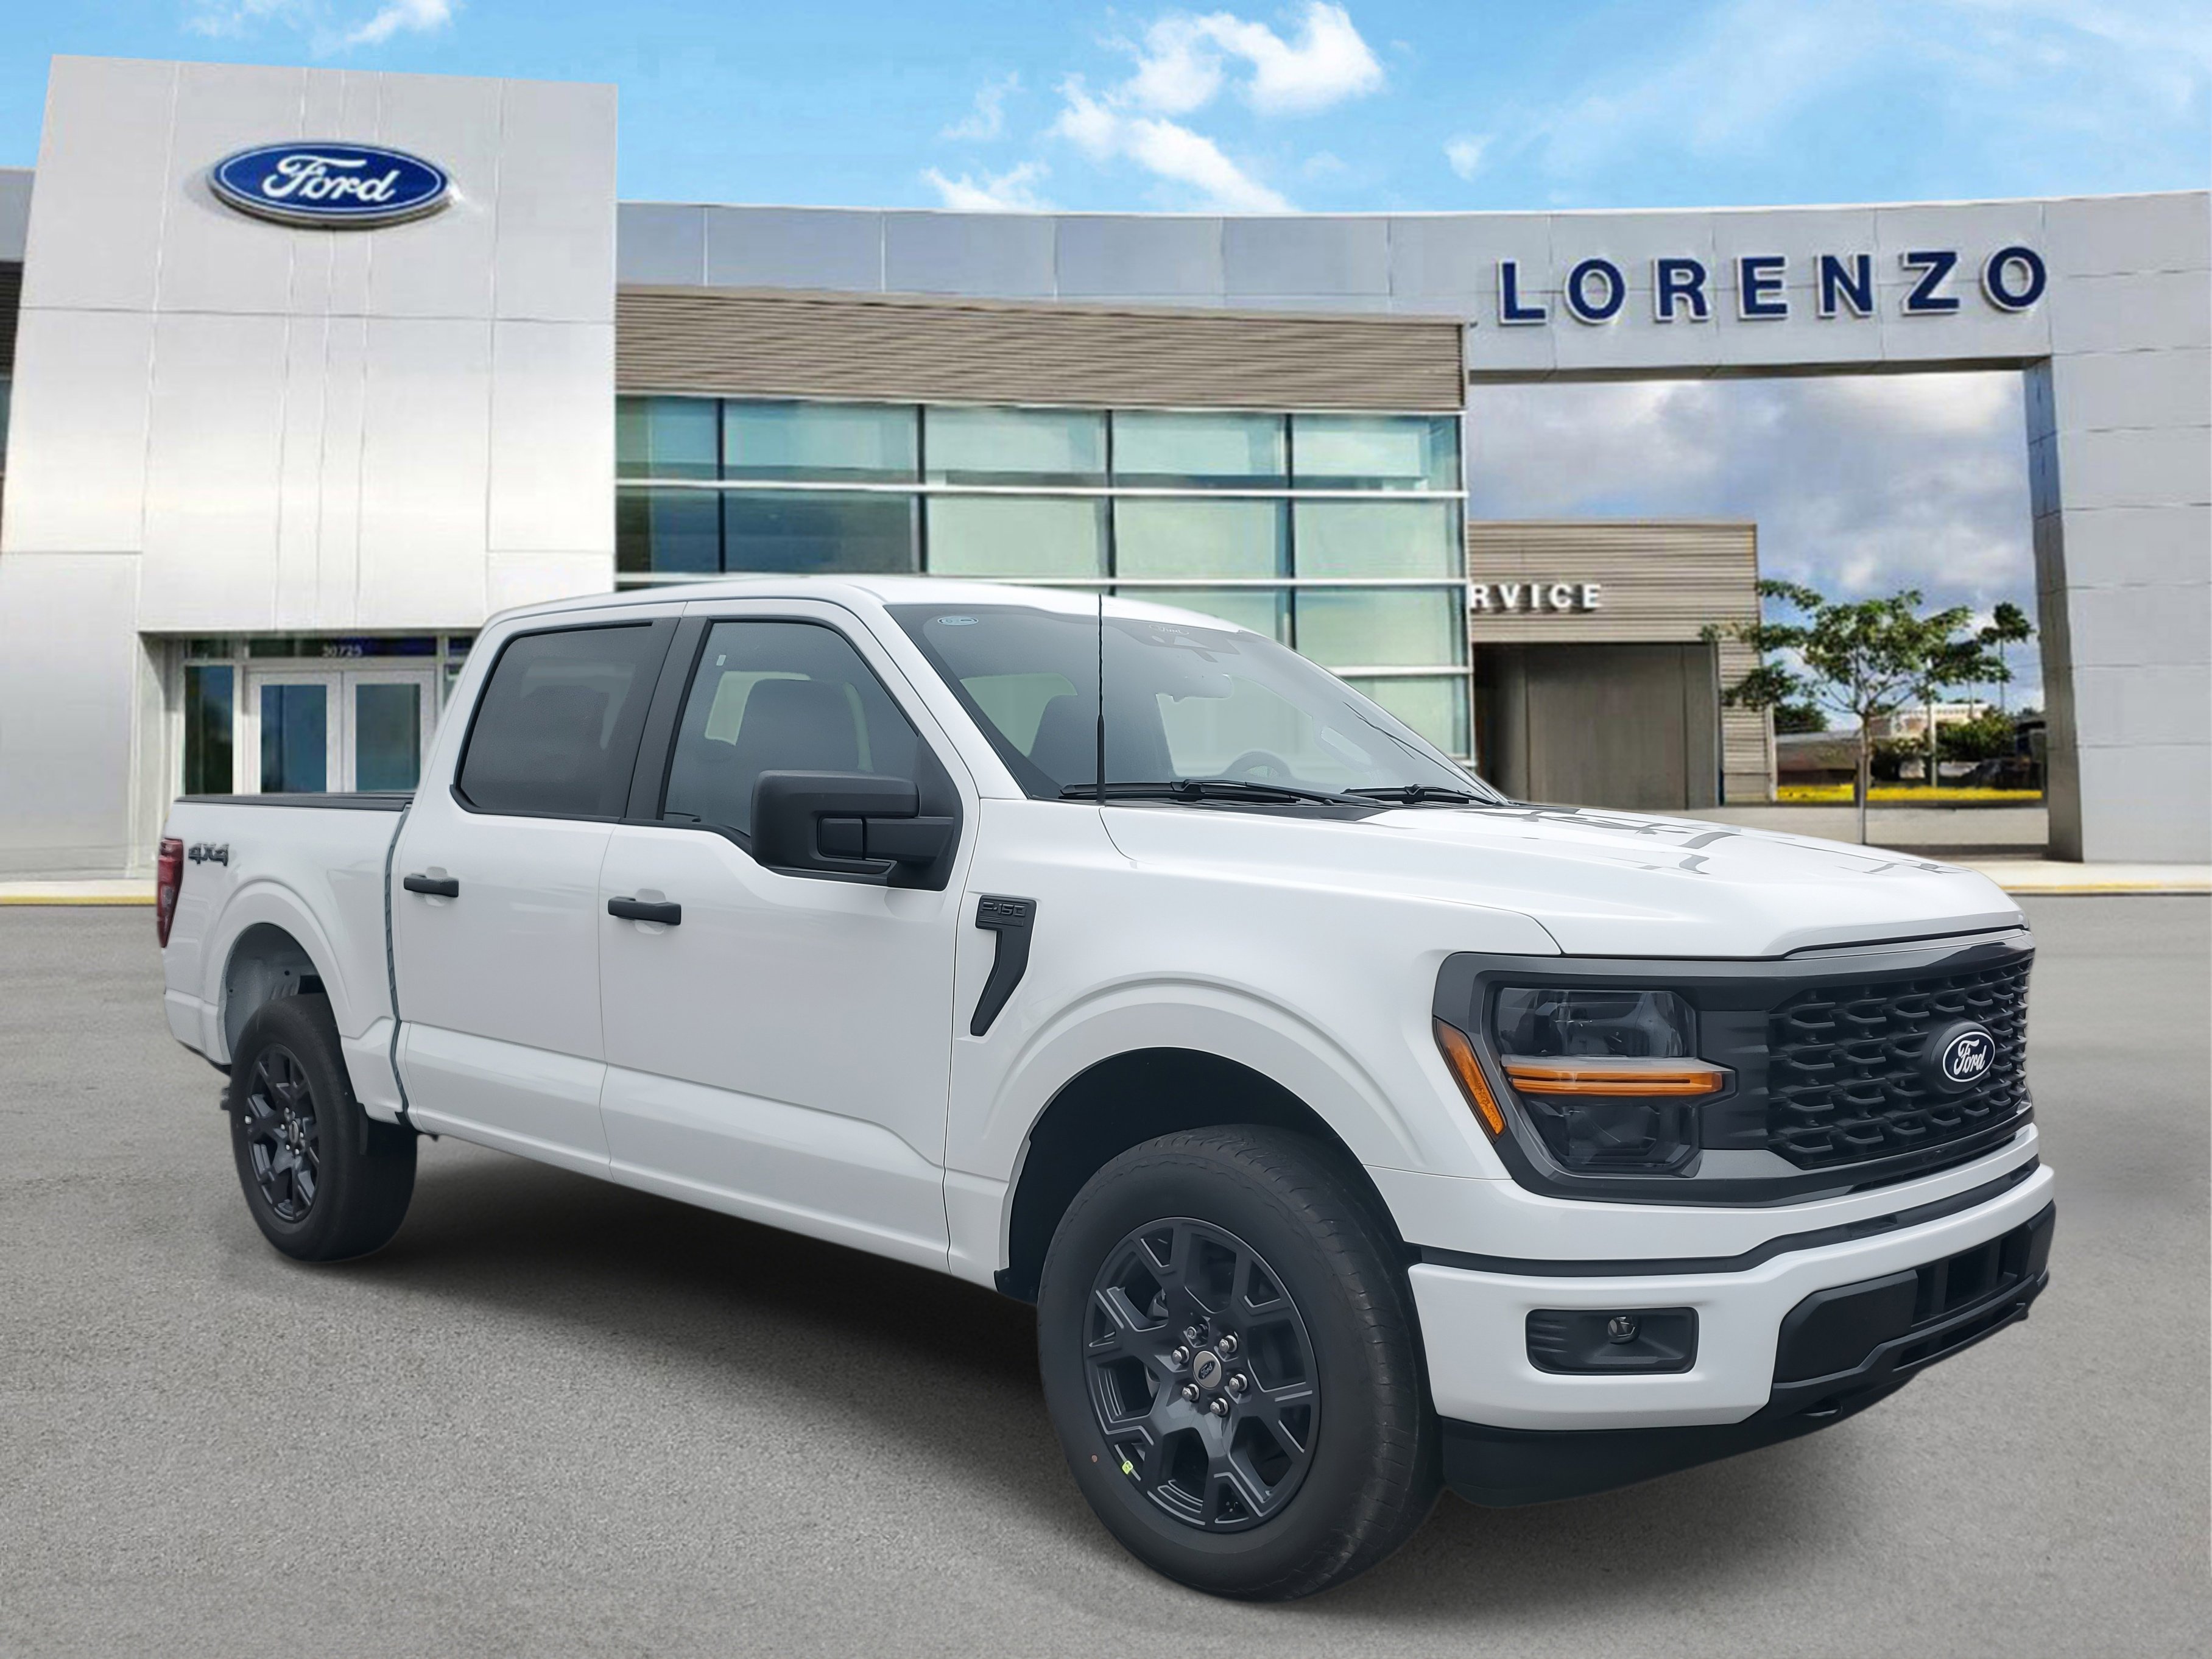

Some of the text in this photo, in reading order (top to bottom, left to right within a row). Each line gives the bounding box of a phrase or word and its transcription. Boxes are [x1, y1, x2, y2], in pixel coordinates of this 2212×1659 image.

[262, 154, 401, 202] Ford
[1498, 245, 2048, 325] LORENZO
[1953, 1038, 1987, 1076] Ford
[1200, 1362, 1213, 1379] Ford
